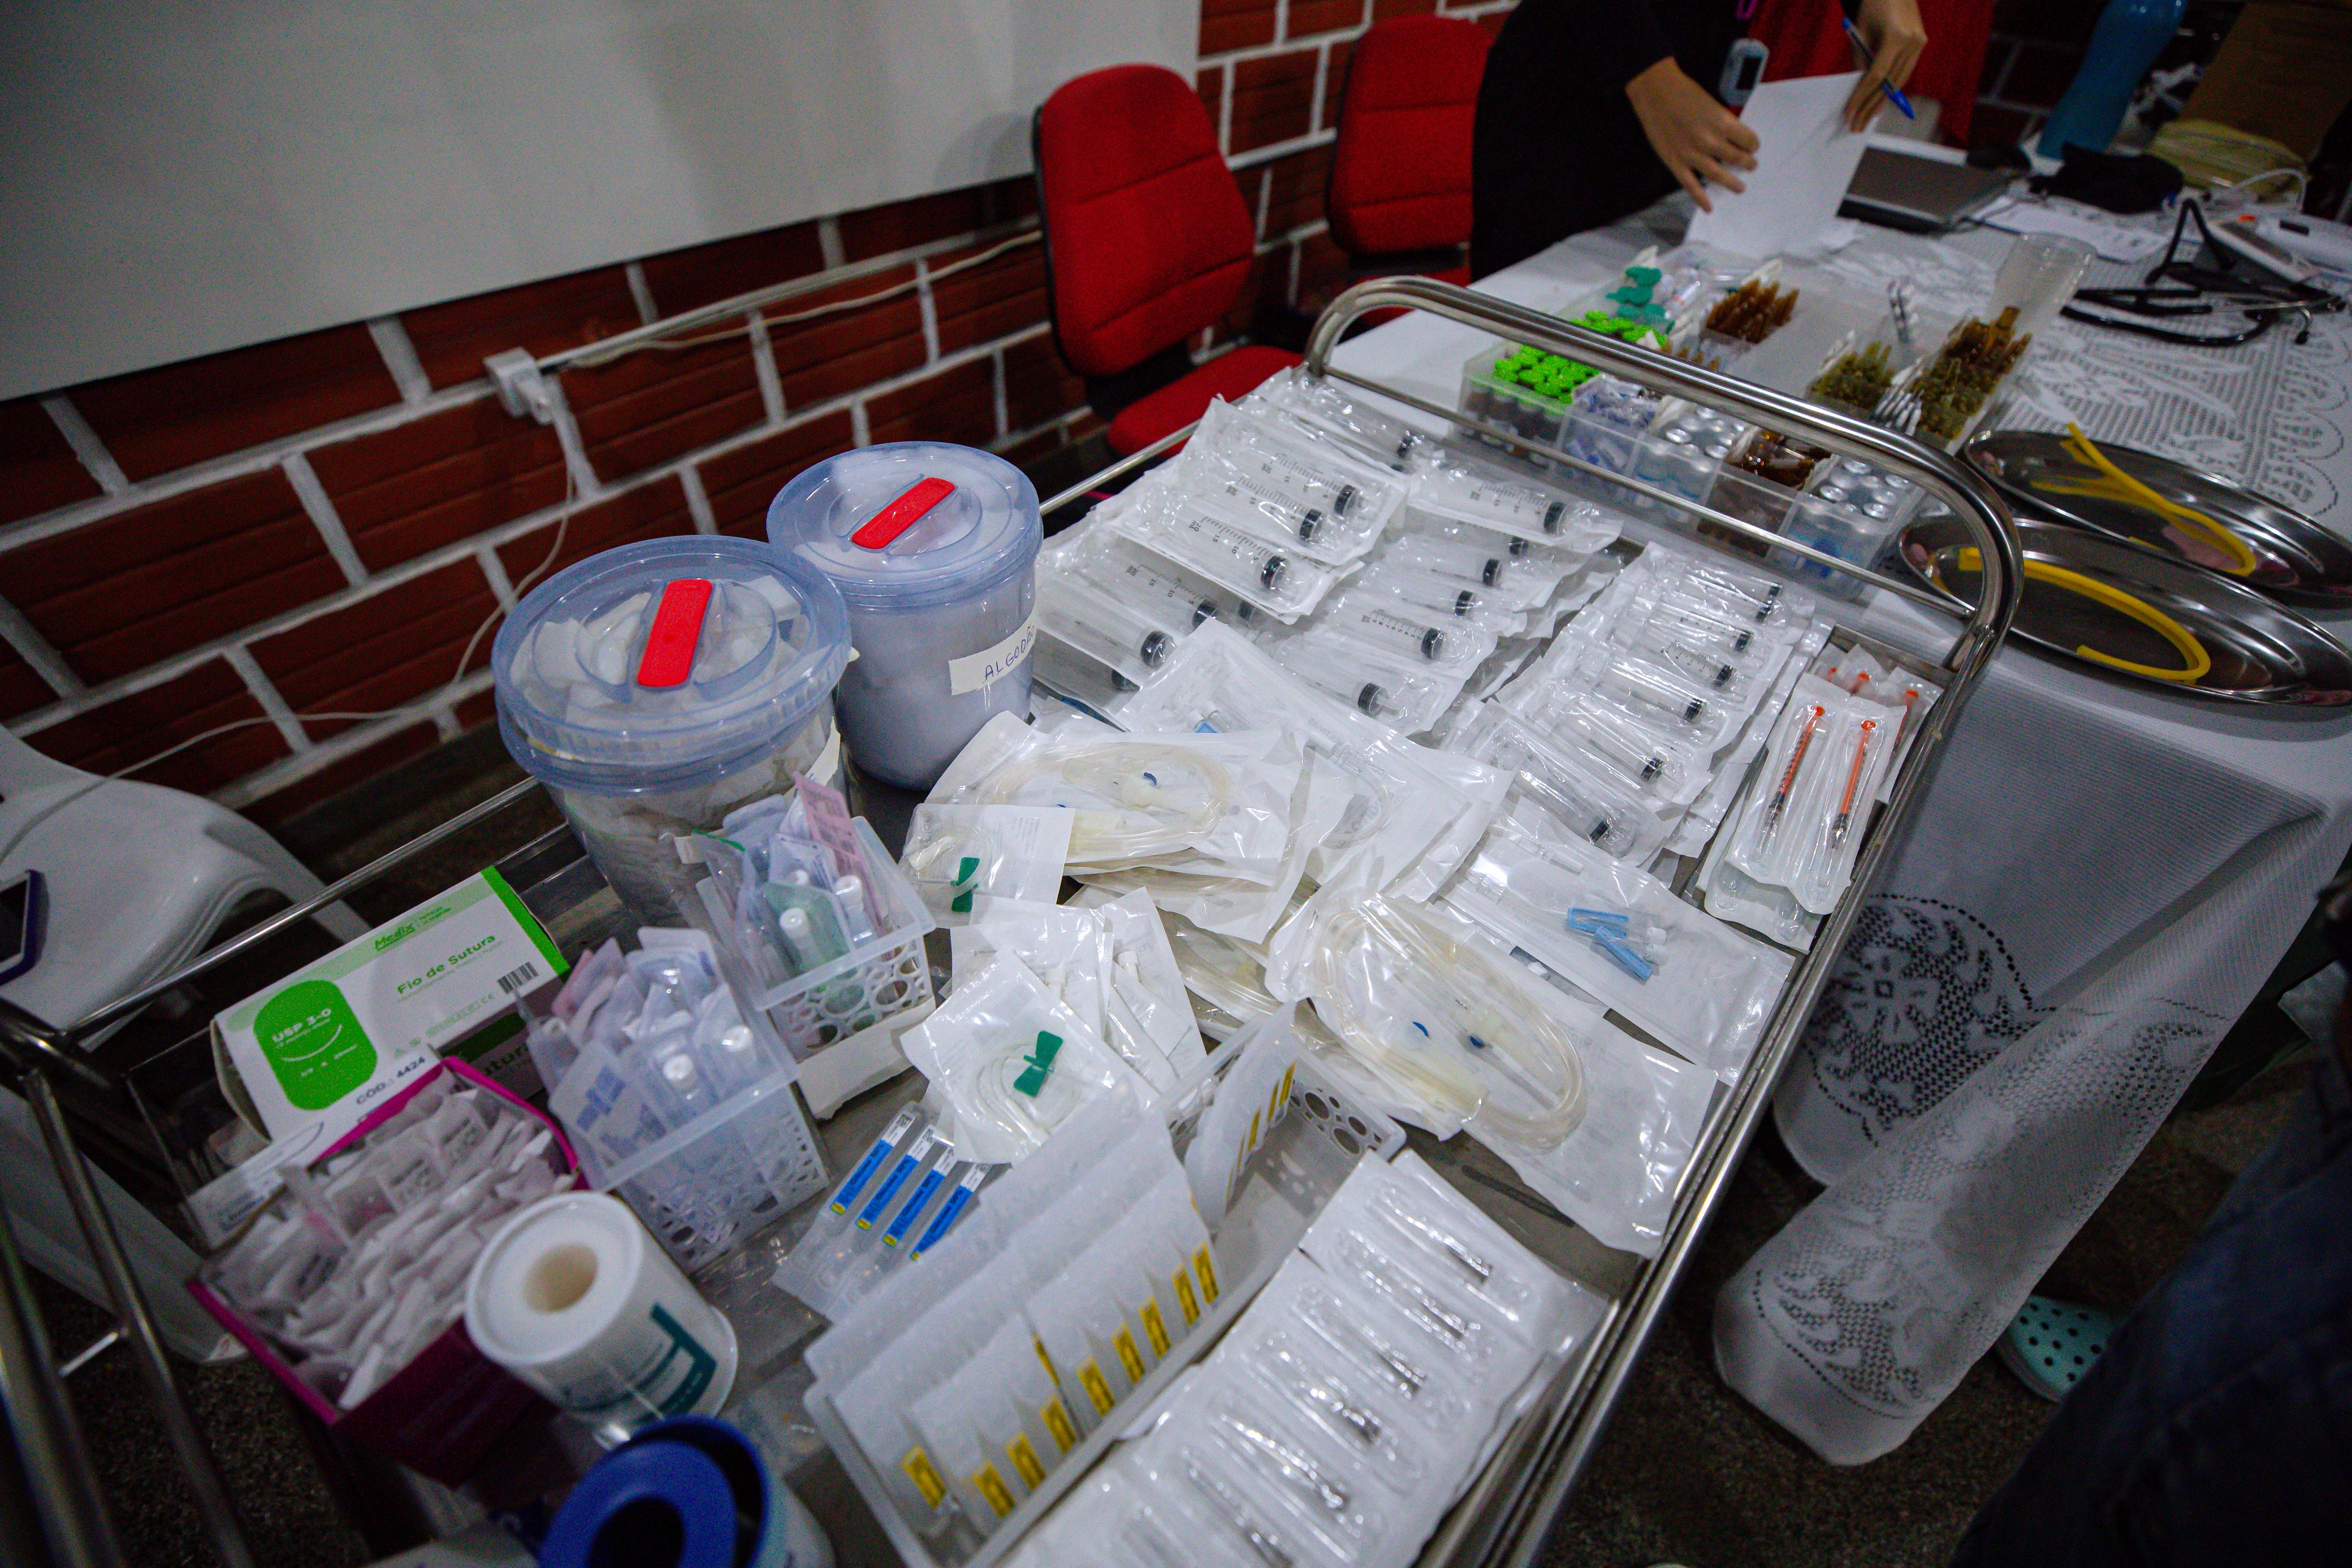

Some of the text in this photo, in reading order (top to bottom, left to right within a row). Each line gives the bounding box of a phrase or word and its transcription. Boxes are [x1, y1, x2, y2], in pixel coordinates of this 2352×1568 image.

[397, 935, 496, 994] Fio de Sutura
[271, 1022, 303, 1042] USP
[397, 1055, 426, 1077] 4424
